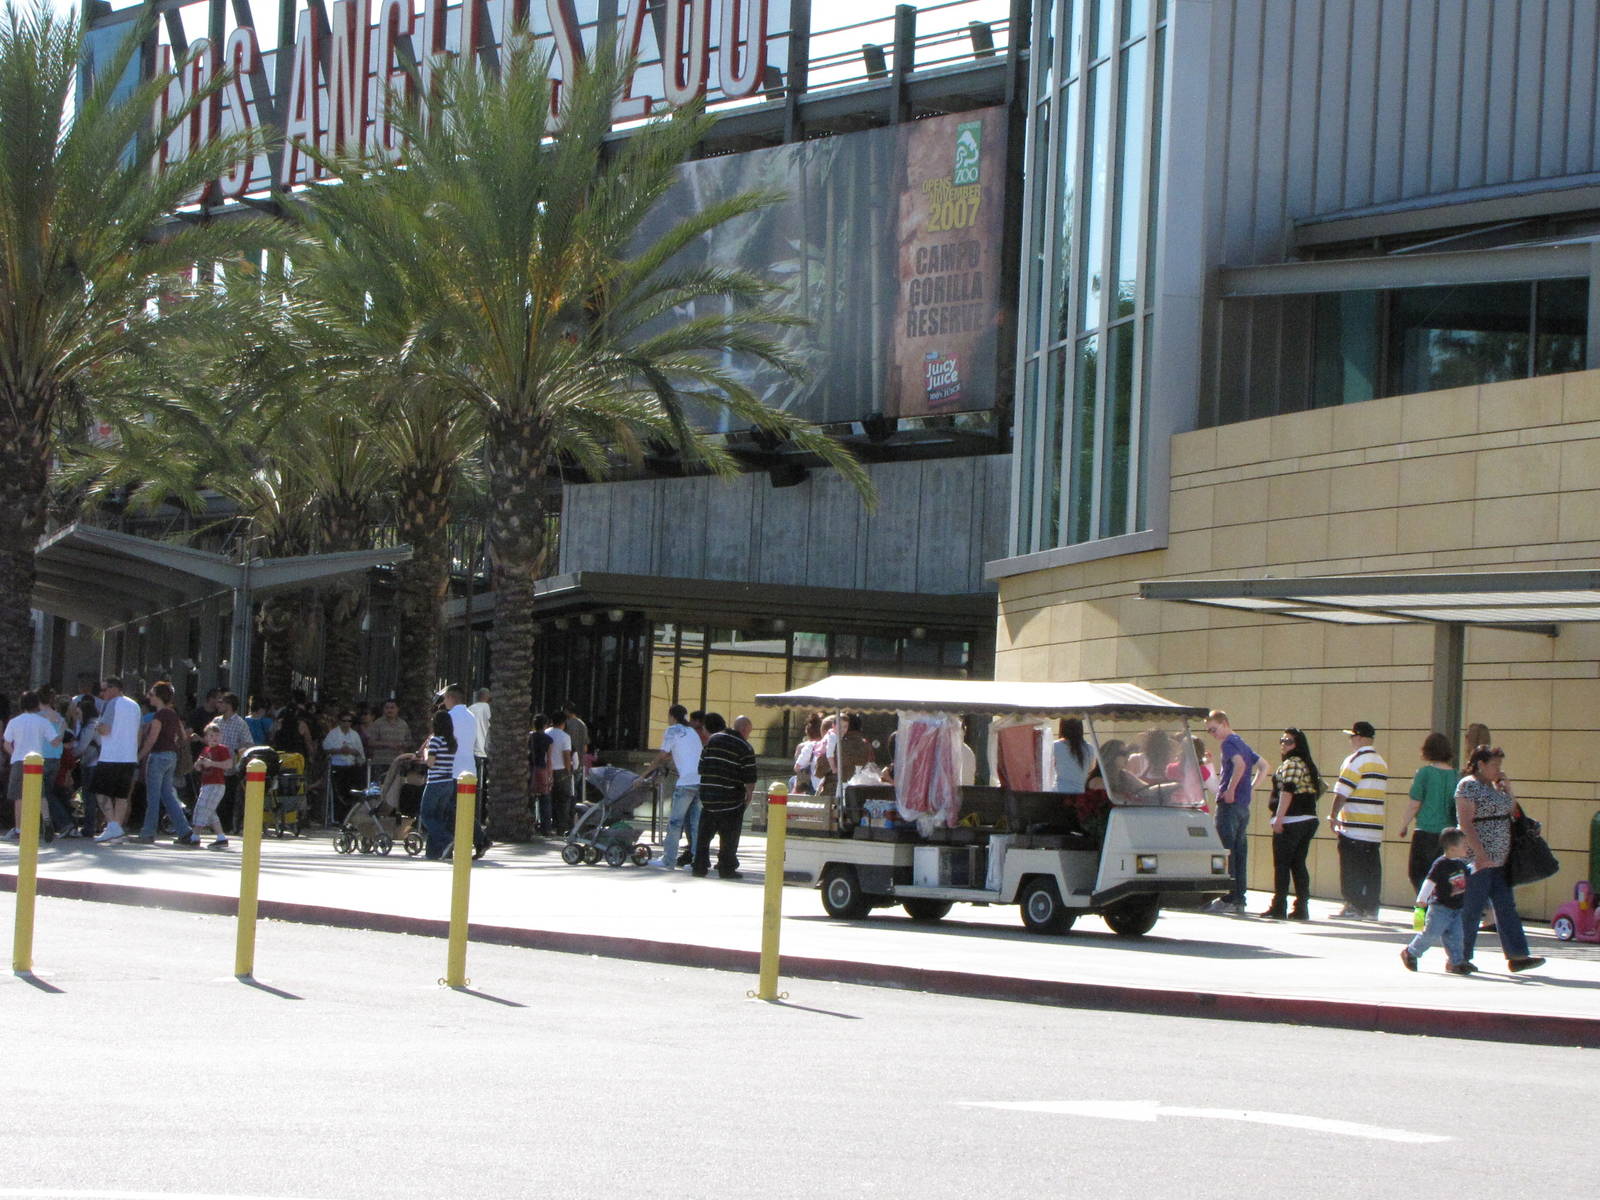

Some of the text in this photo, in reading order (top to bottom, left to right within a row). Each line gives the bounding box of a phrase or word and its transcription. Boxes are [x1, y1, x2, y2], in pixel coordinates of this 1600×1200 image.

[922, 175, 952, 193] OPENS
[954, 167, 978, 184] ZOO
[928, 184, 981, 204] NOVEMBER
[927, 198, 981, 233] 2007
[916, 240, 981, 275] CAMPO
[910, 271, 984, 307] GORILLA
[906, 303, 984, 338] RESERVE
